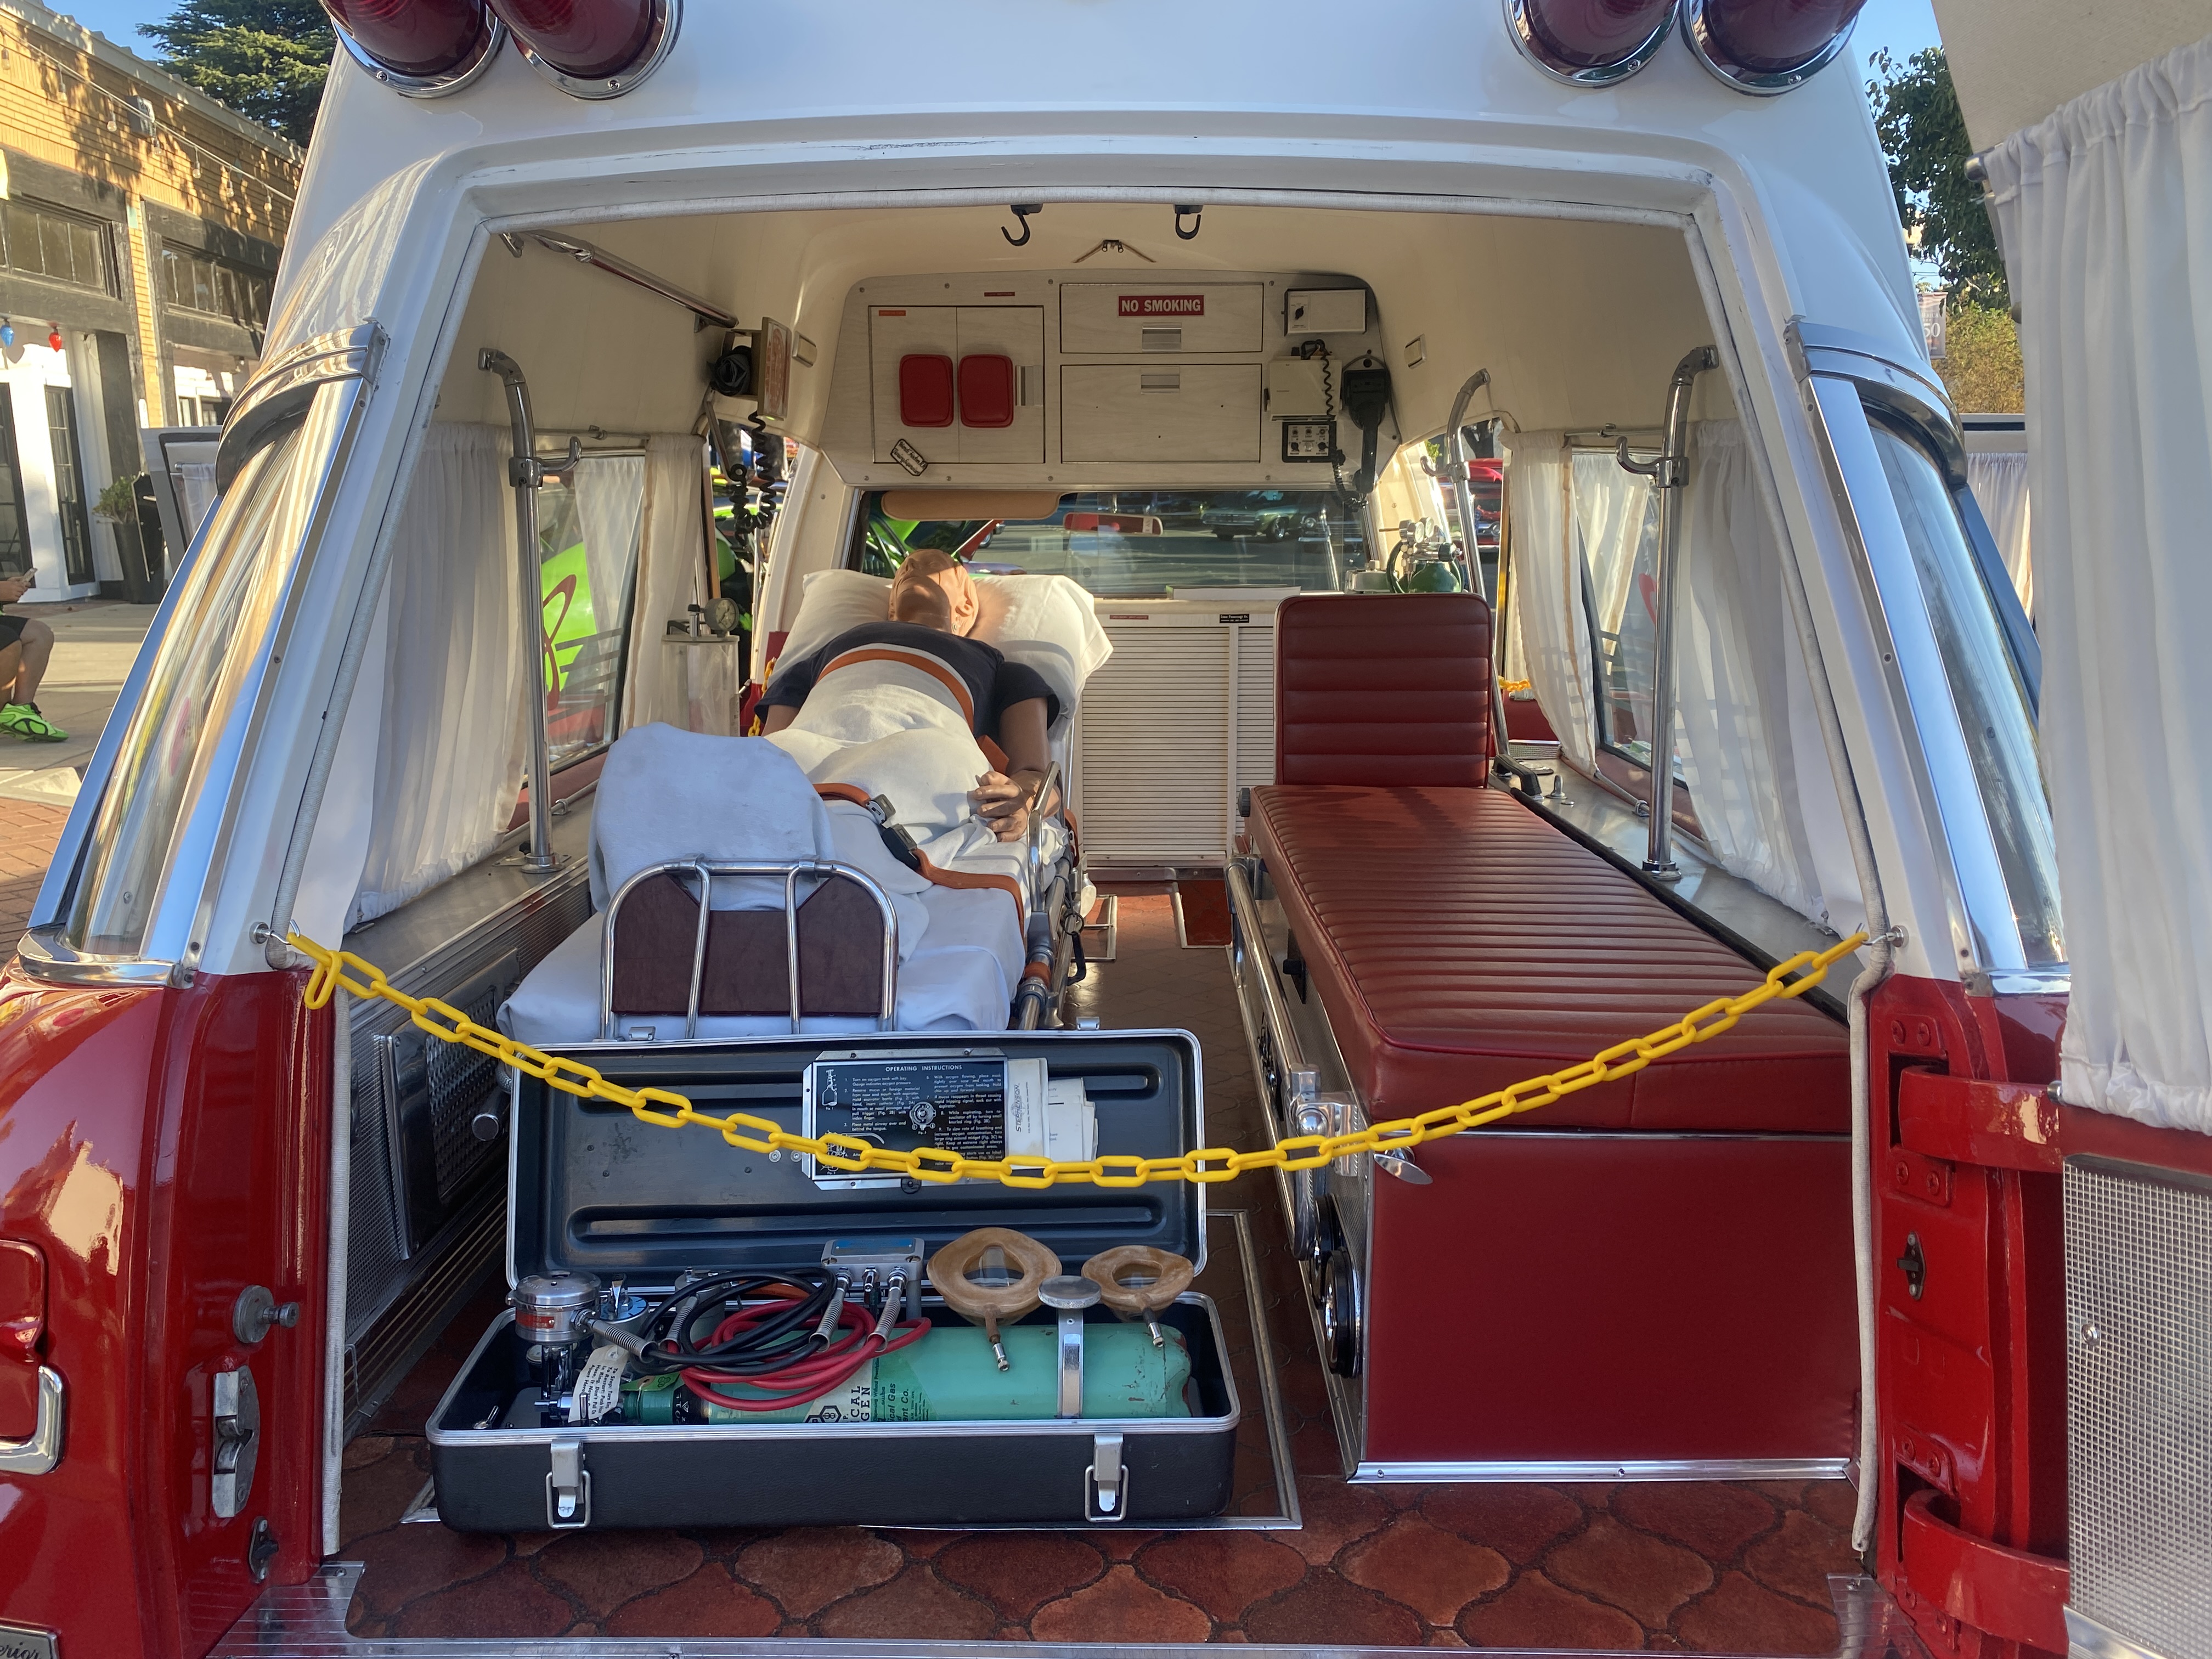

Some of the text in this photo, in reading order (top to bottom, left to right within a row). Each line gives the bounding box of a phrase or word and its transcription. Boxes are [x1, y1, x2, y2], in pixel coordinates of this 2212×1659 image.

[1122, 300, 1200, 312] NO SMOKING
[1923, 323, 1940, 337] 50
[586, 1364, 594, 1378] Apart
[850, 1386, 860, 1423] ICAL
[861, 1387, 870, 1421] GEN
[0, 1642, 40, 1659] erior
